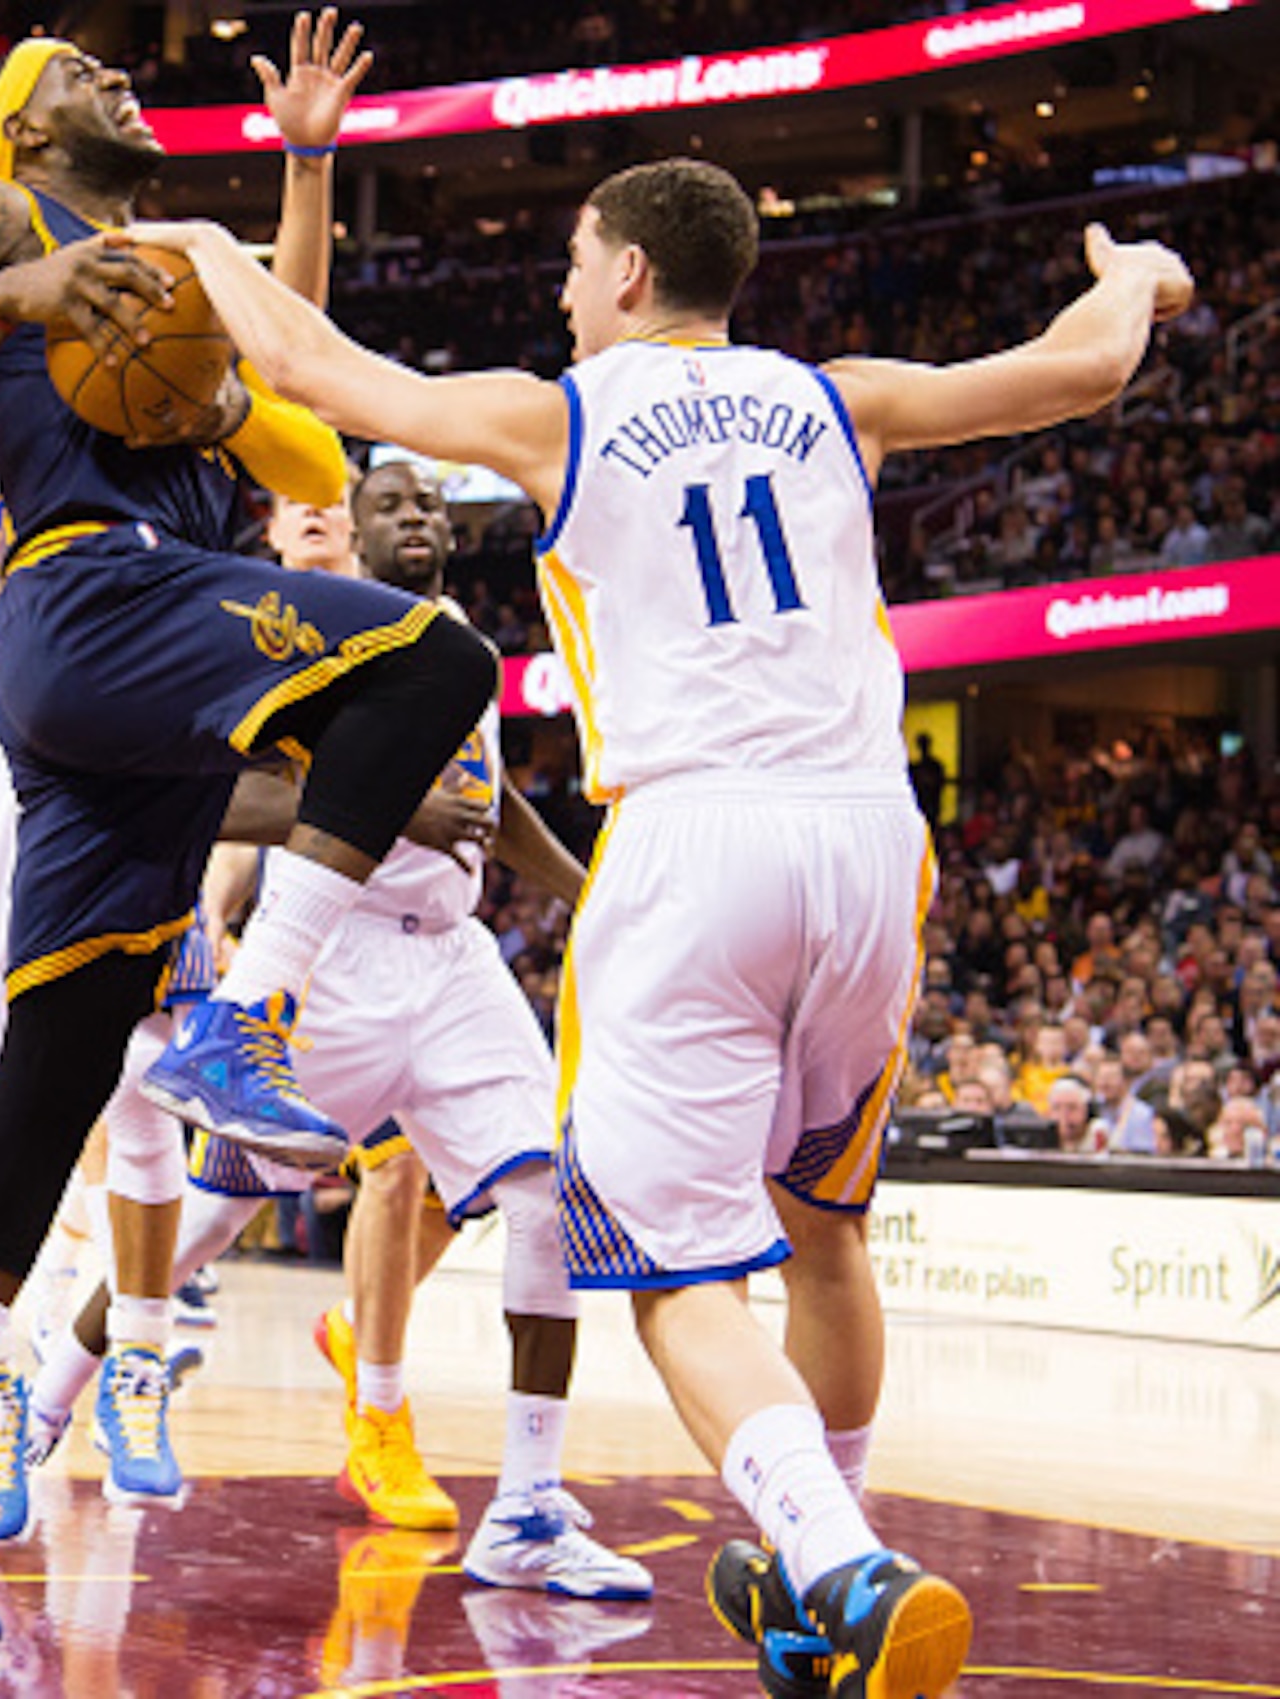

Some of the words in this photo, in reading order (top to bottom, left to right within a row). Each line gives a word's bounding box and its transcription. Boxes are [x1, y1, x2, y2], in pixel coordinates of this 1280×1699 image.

[492, 66, 676, 129] Quicken
[678, 54, 828, 103] Loans
[600, 394, 828, 478] THOMPSON
[675, 470, 811, 627] 11
[868, 1208, 926, 1244] ent.
[871, 1254, 914, 1289] T&T
[924, 1264, 979, 1294] rate
[984, 1262, 1050, 1303] plan
[1110, 1244, 1231, 1311] Sprint
